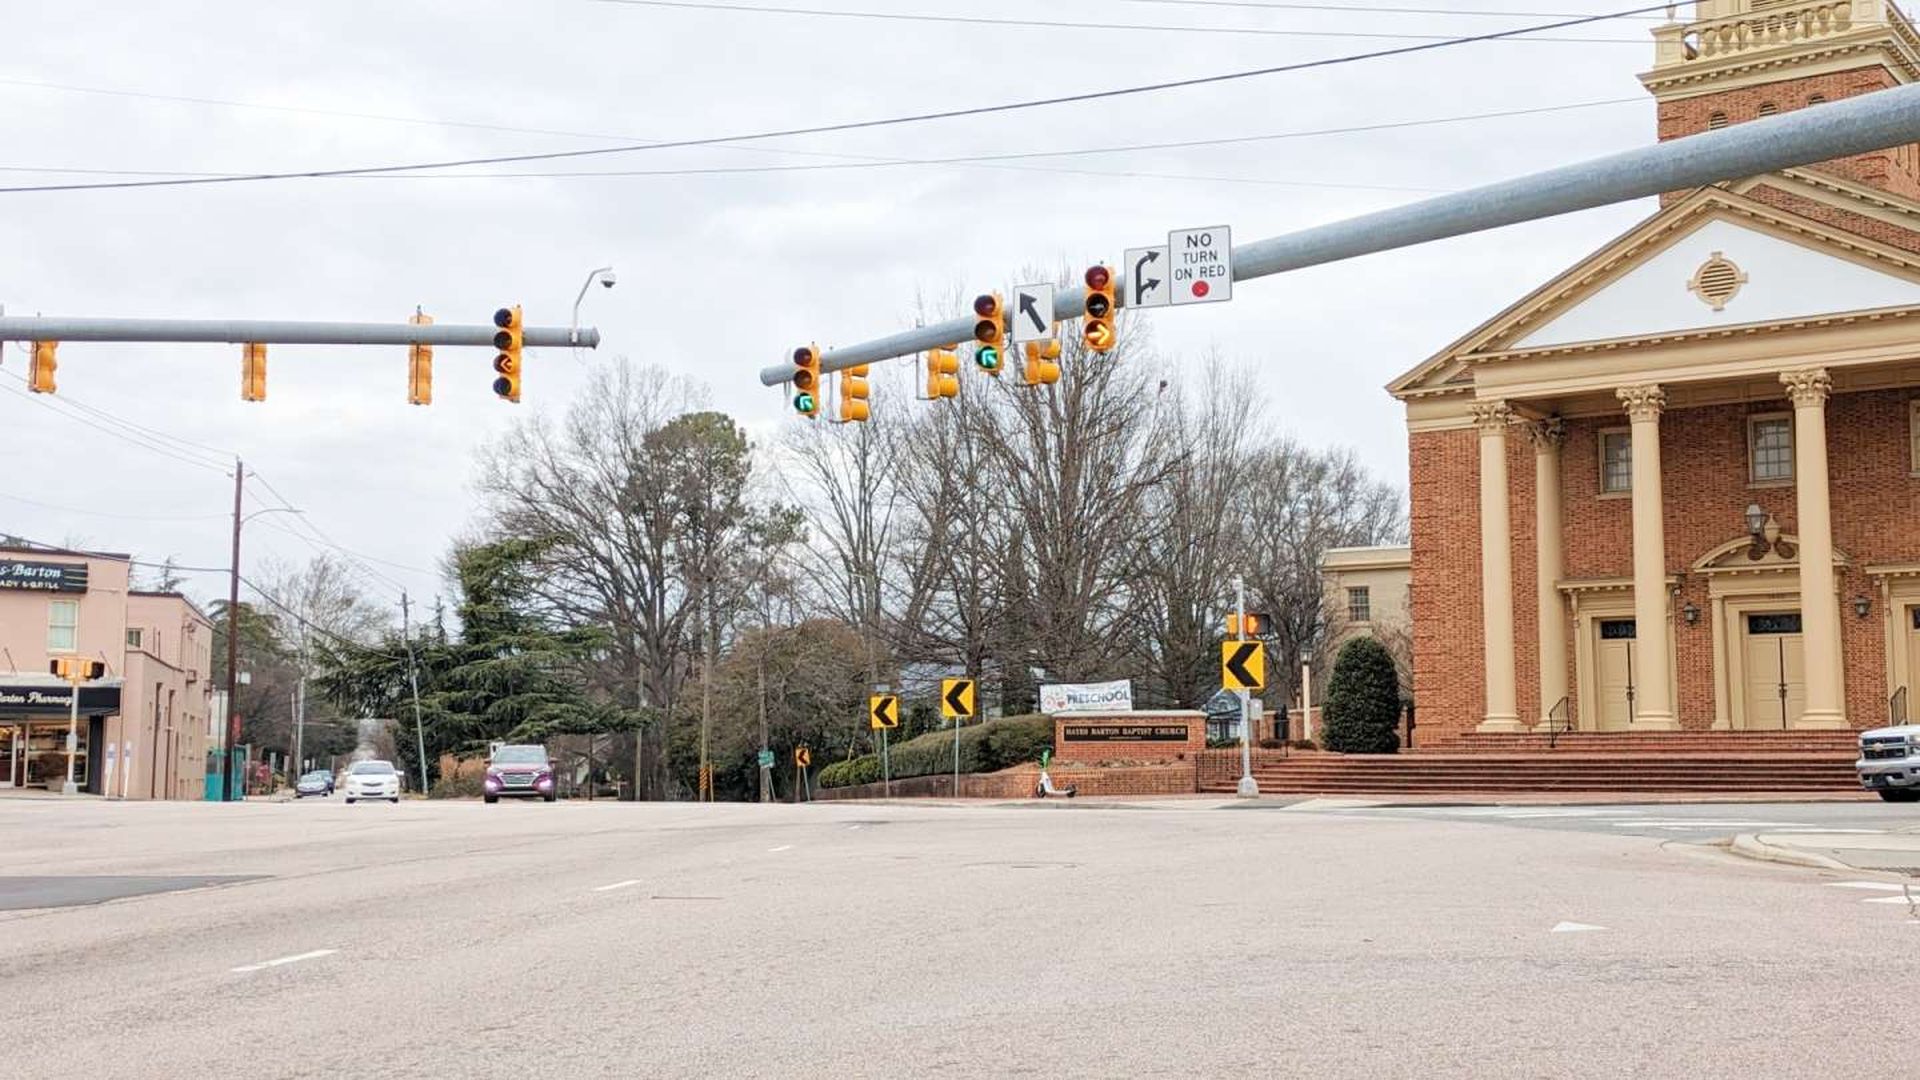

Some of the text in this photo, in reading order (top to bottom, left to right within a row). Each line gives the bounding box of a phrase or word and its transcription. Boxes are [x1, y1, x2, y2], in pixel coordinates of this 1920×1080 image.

[1187, 233, 1212, 248] NO
[1183, 250, 1217, 264] TURN
[1175, 265, 1226, 281] ON RED
[12, 563, 61, 578] Barton
[27, 691, 73, 706] Pharmacy
[1066, 690, 1130, 705] PRESCHOOL
[1091, 728, 1119, 736] BARTON
[1122, 728, 1152, 736] BAPTIST
